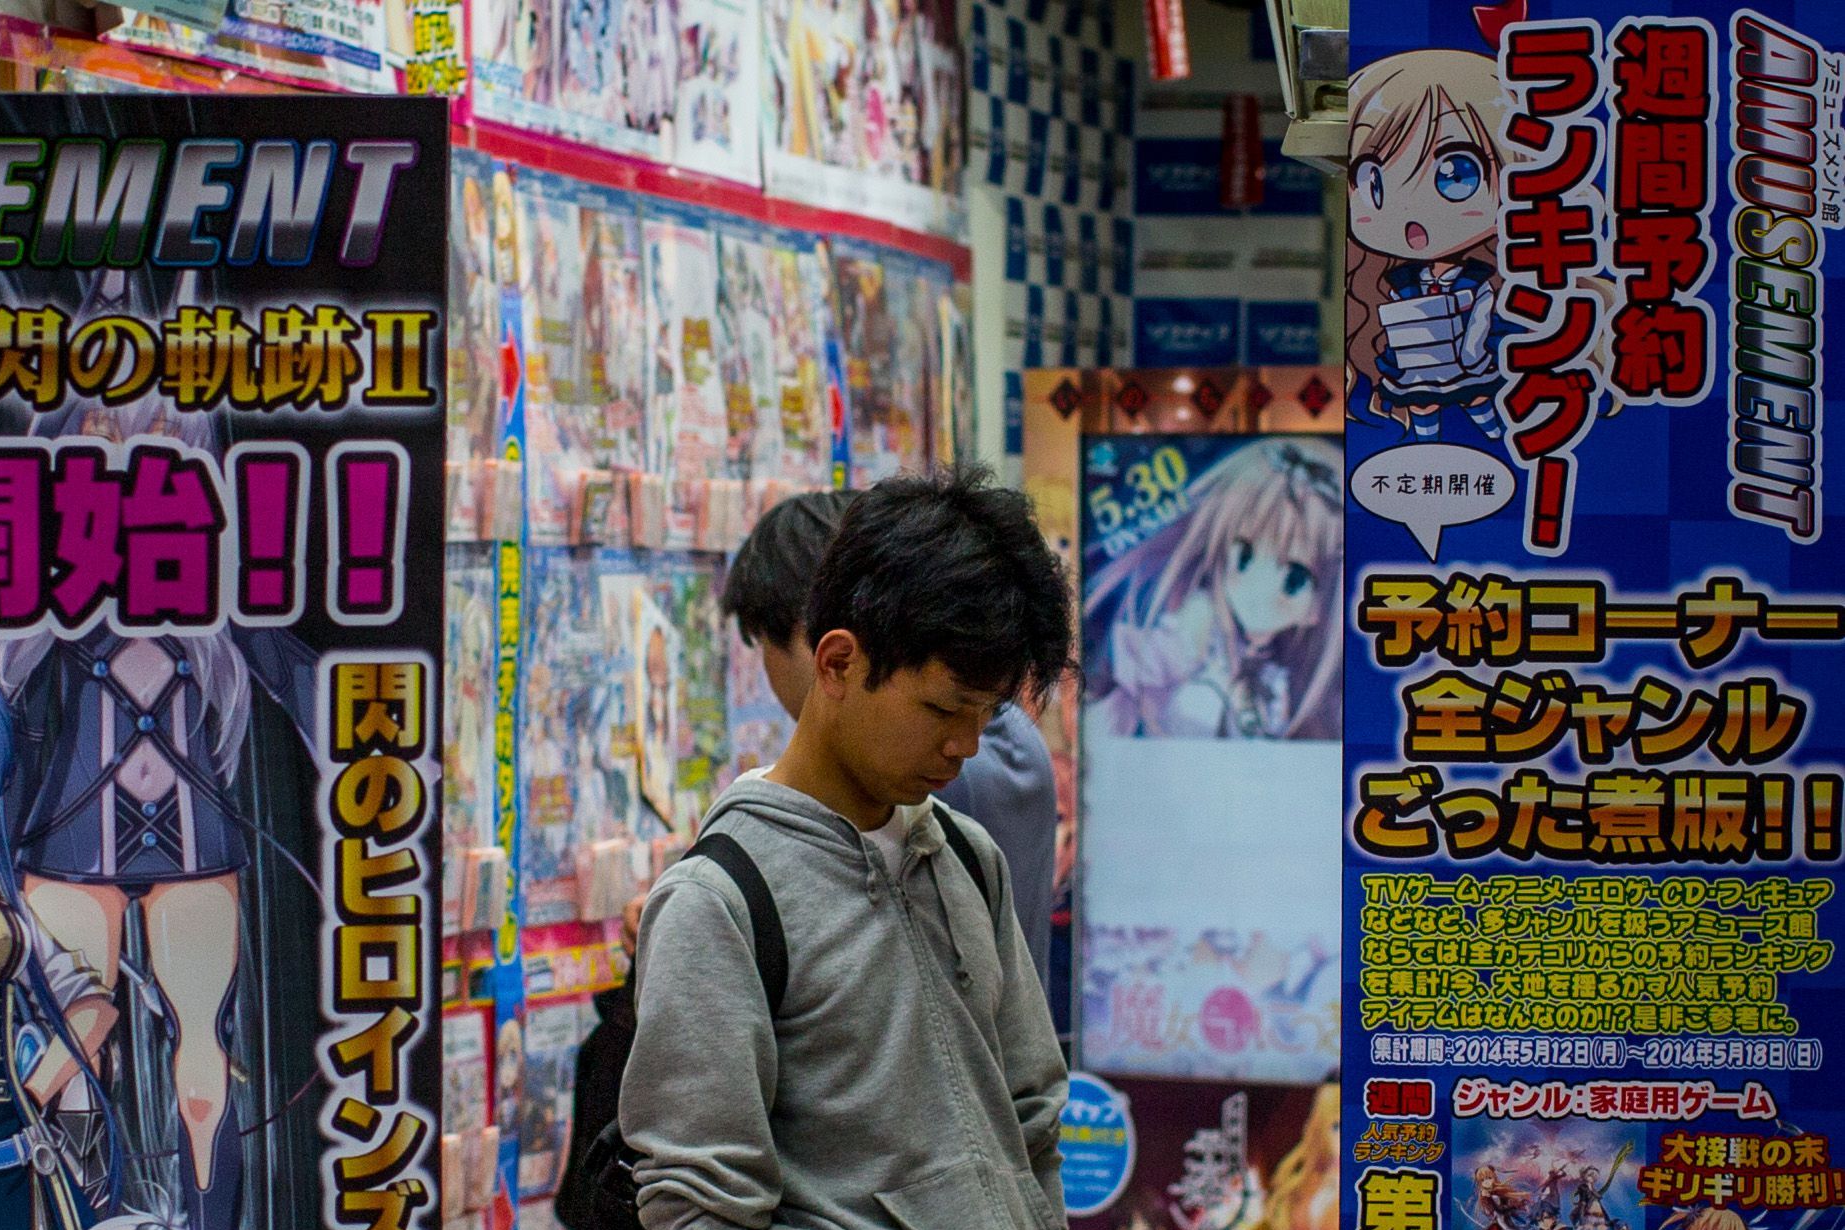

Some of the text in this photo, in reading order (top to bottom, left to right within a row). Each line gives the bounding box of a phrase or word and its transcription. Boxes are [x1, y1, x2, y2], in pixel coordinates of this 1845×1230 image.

[1821, 58, 1841, 224] アミューズメント館
[1612, 26, 1711, 399] 週間予約
[1504, 26, 1598, 548] ランキング!
[1732, 14, 1818, 537] AMUSEMENT
[1090, 445, 1189, 536] 5.30
[1370, 473, 1496, 496] 不定期開催
[1358, 573, 1845, 667] 予約コーナー
[1402, 670, 1807, 764] 全ジャンル
[1354, 766, 1843, 866] ごった煮版!!
[1452, 1079, 1776, 1121] ジャンル:家庭用ゲーム
[1354, 1142, 1445, 1163] ランキング
[1638, 1169, 1845, 1207] ギリギリ勝利!
[1659, 1134, 1830, 1169] 大接戦の末
